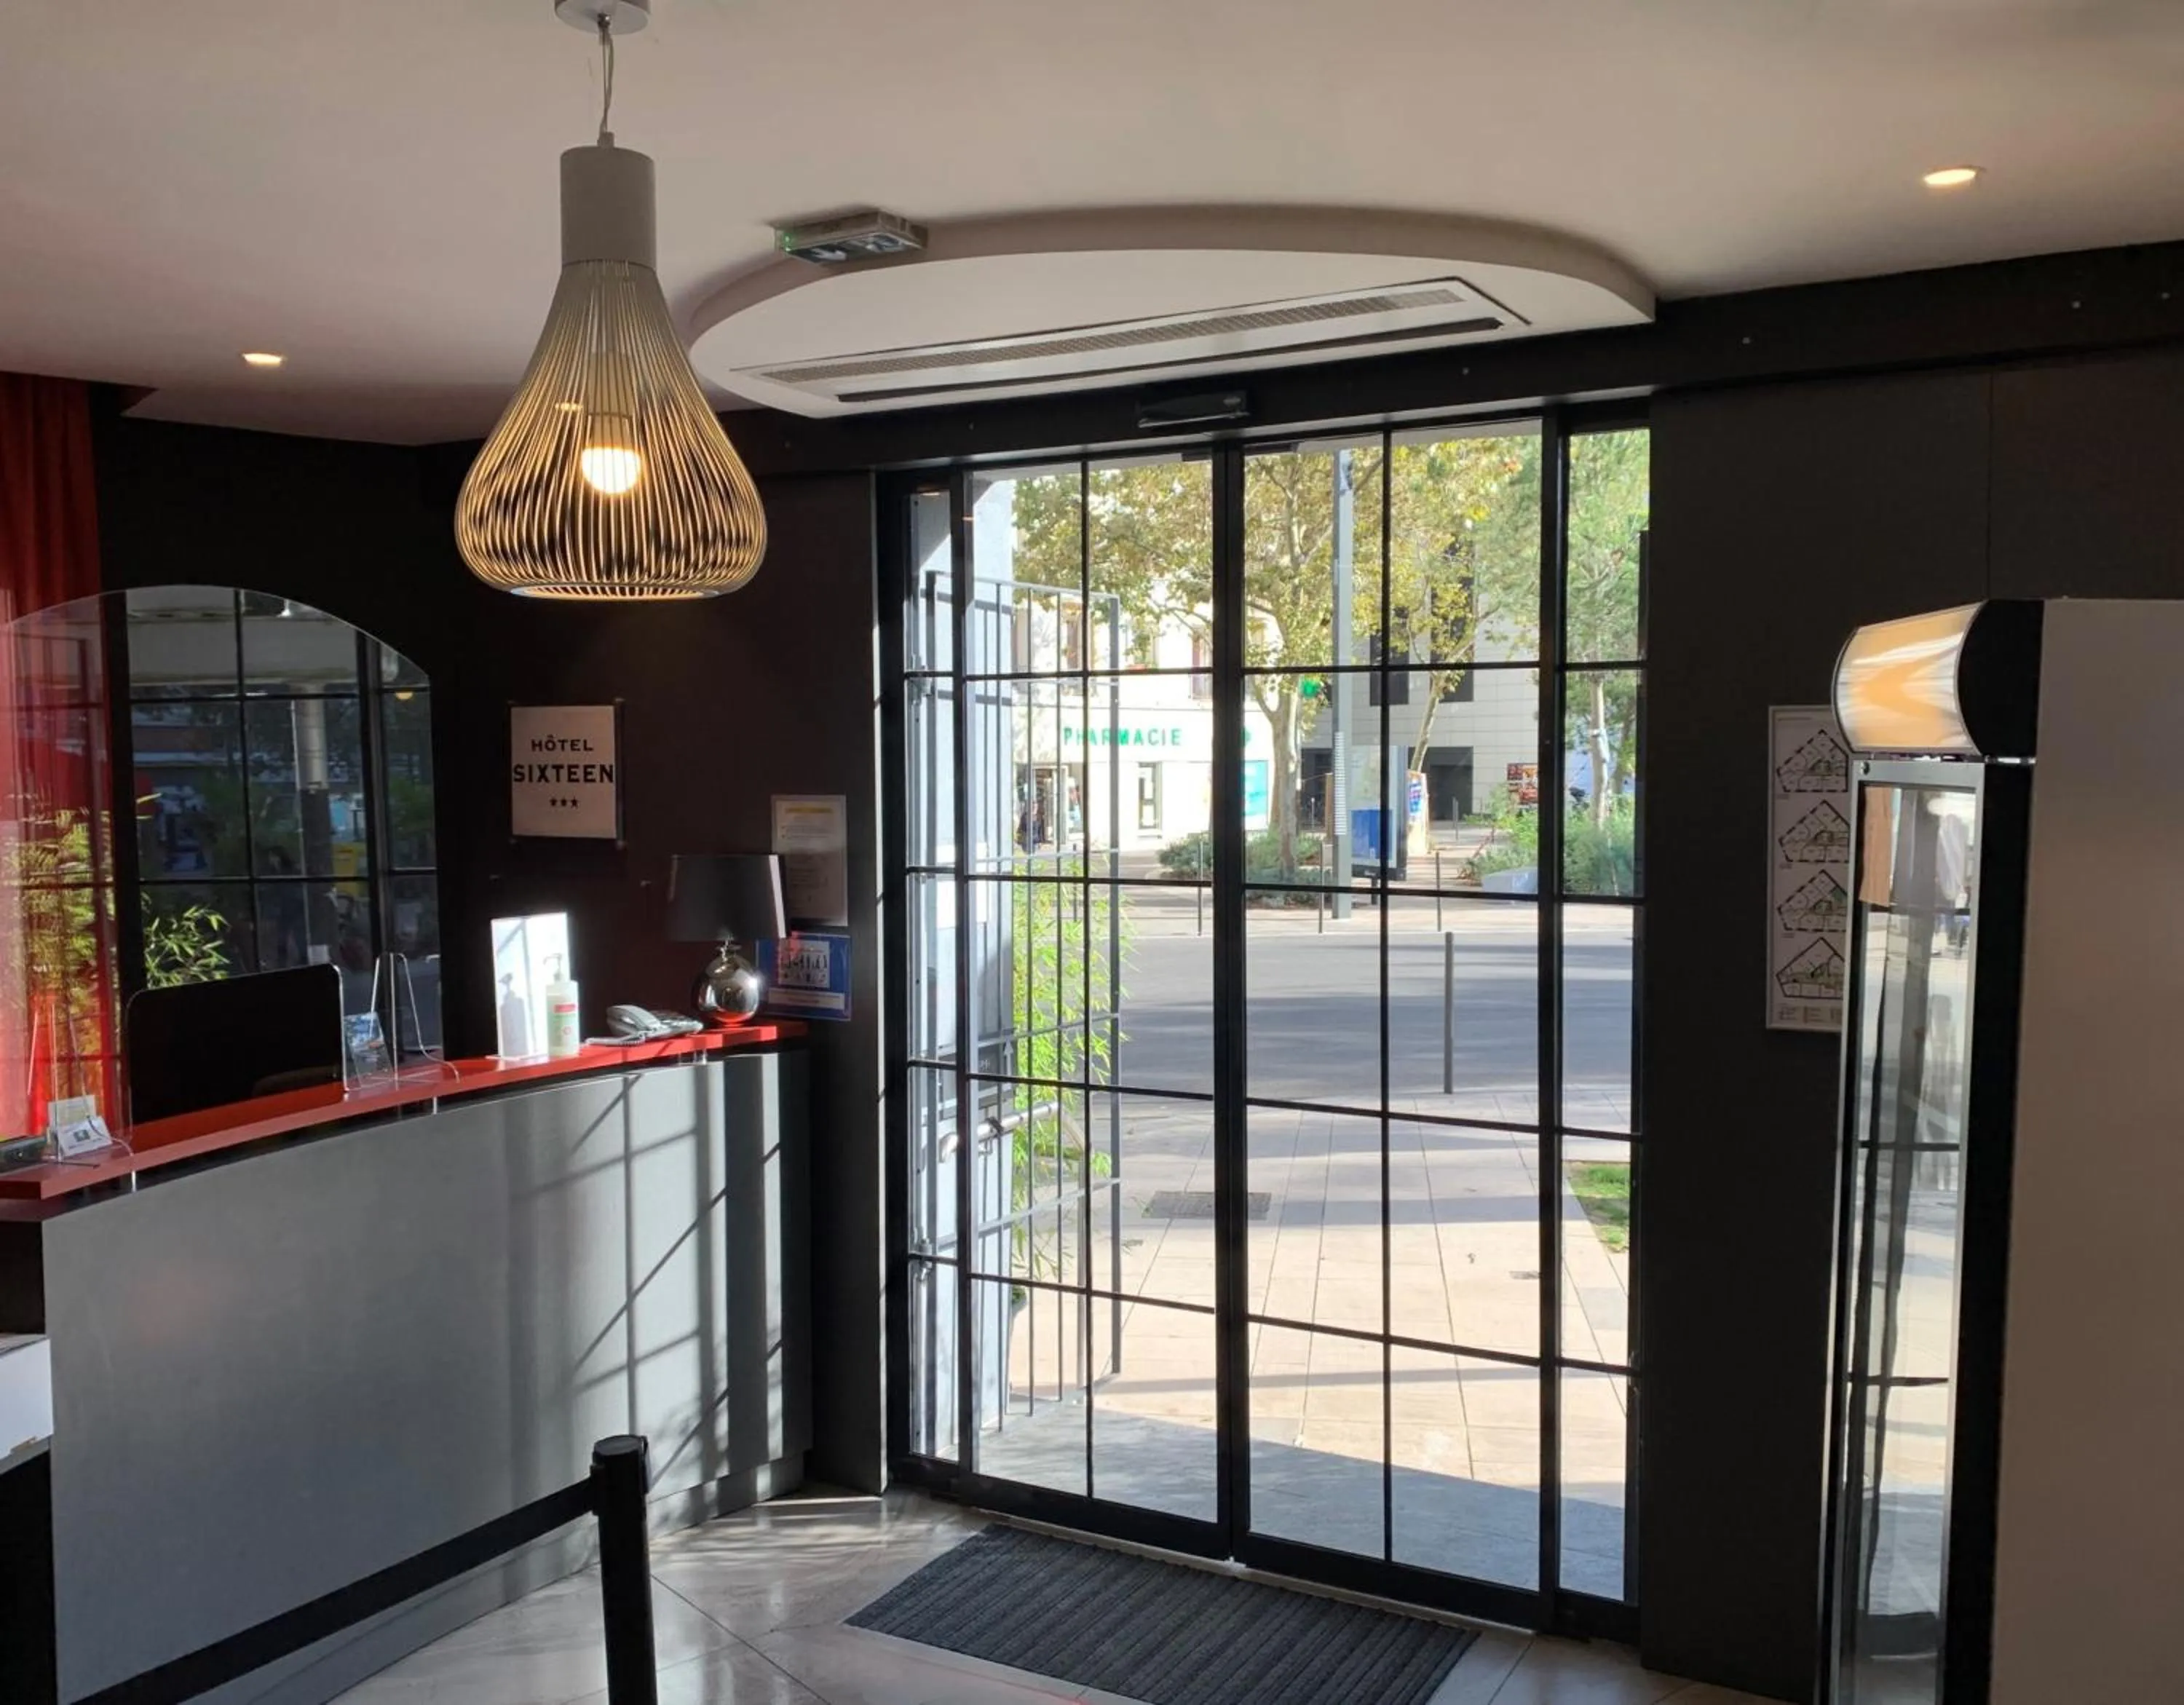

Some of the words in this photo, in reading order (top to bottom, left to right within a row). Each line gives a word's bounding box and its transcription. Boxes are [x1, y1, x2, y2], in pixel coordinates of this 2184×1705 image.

[531, 735, 594, 752] HÔTEL
[1063, 727, 1182, 745] PHARMACIE
[513, 764, 614, 783] SIXTEEN
